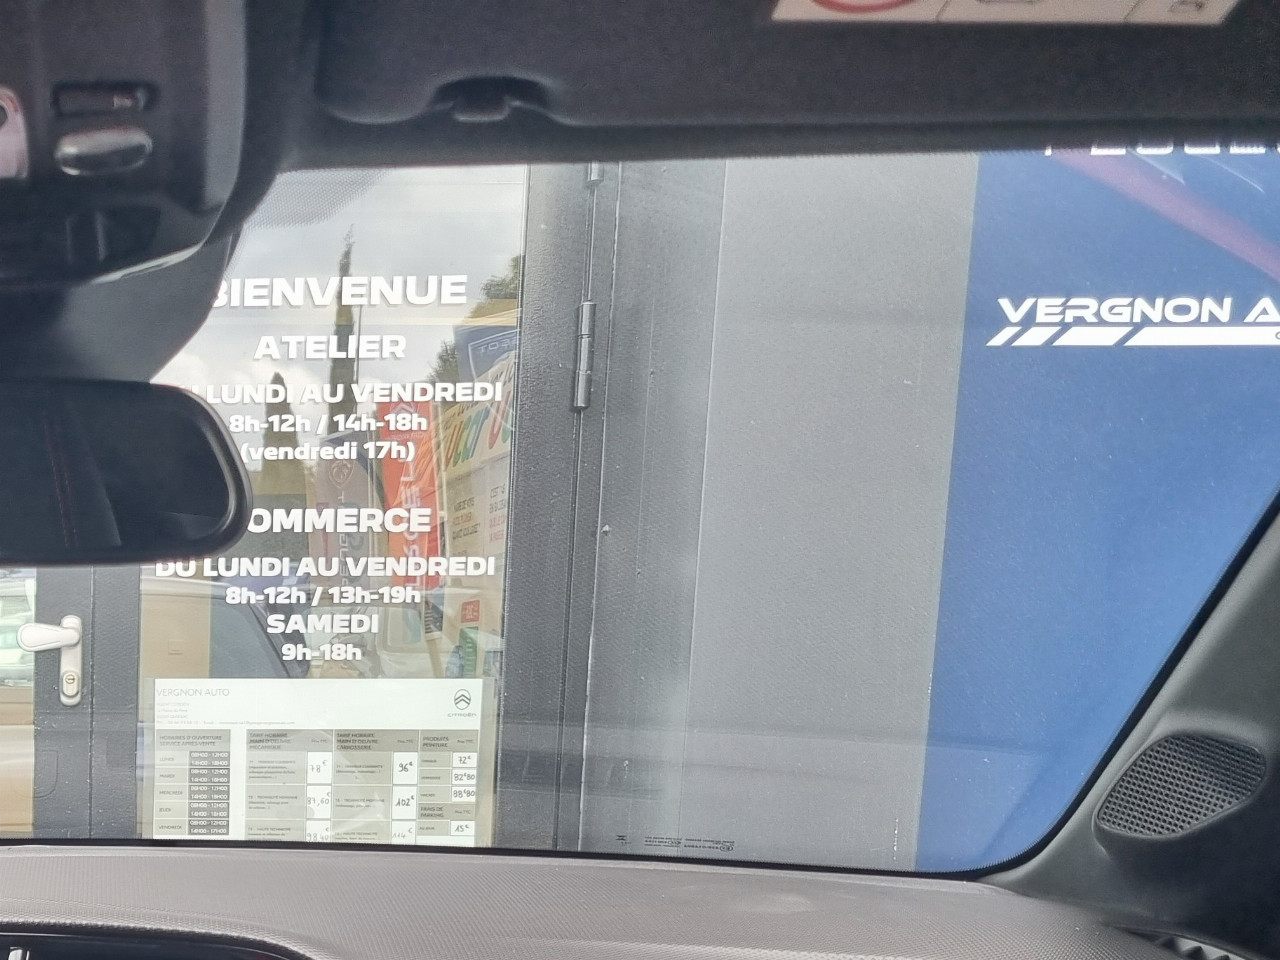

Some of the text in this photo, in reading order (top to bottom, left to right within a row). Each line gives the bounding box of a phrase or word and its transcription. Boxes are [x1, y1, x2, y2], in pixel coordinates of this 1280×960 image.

[998, 297, 1232, 324] VERGNON
[254, 334, 406, 360] ATELIER
[207, 383, 293, 404] LUNDI
[301, 383, 344, 404] AU
[351, 382, 502, 403] VENDREDI
[229, 413, 428, 434] 8h-12h / 14h-18h
[241, 441, 417, 463] (vendredi 17h)
[247, 508, 431, 534] OMMERCE
[155, 556, 495, 577] DU LUNDI AU VENDREDI
[225, 587, 421, 606] 8h-12h / 13h-19h
[266, 614, 379, 634] SAMEDI
[282, 643, 362, 661] 9h-18h
[157, 688, 230, 697] VERGNON AUTO
